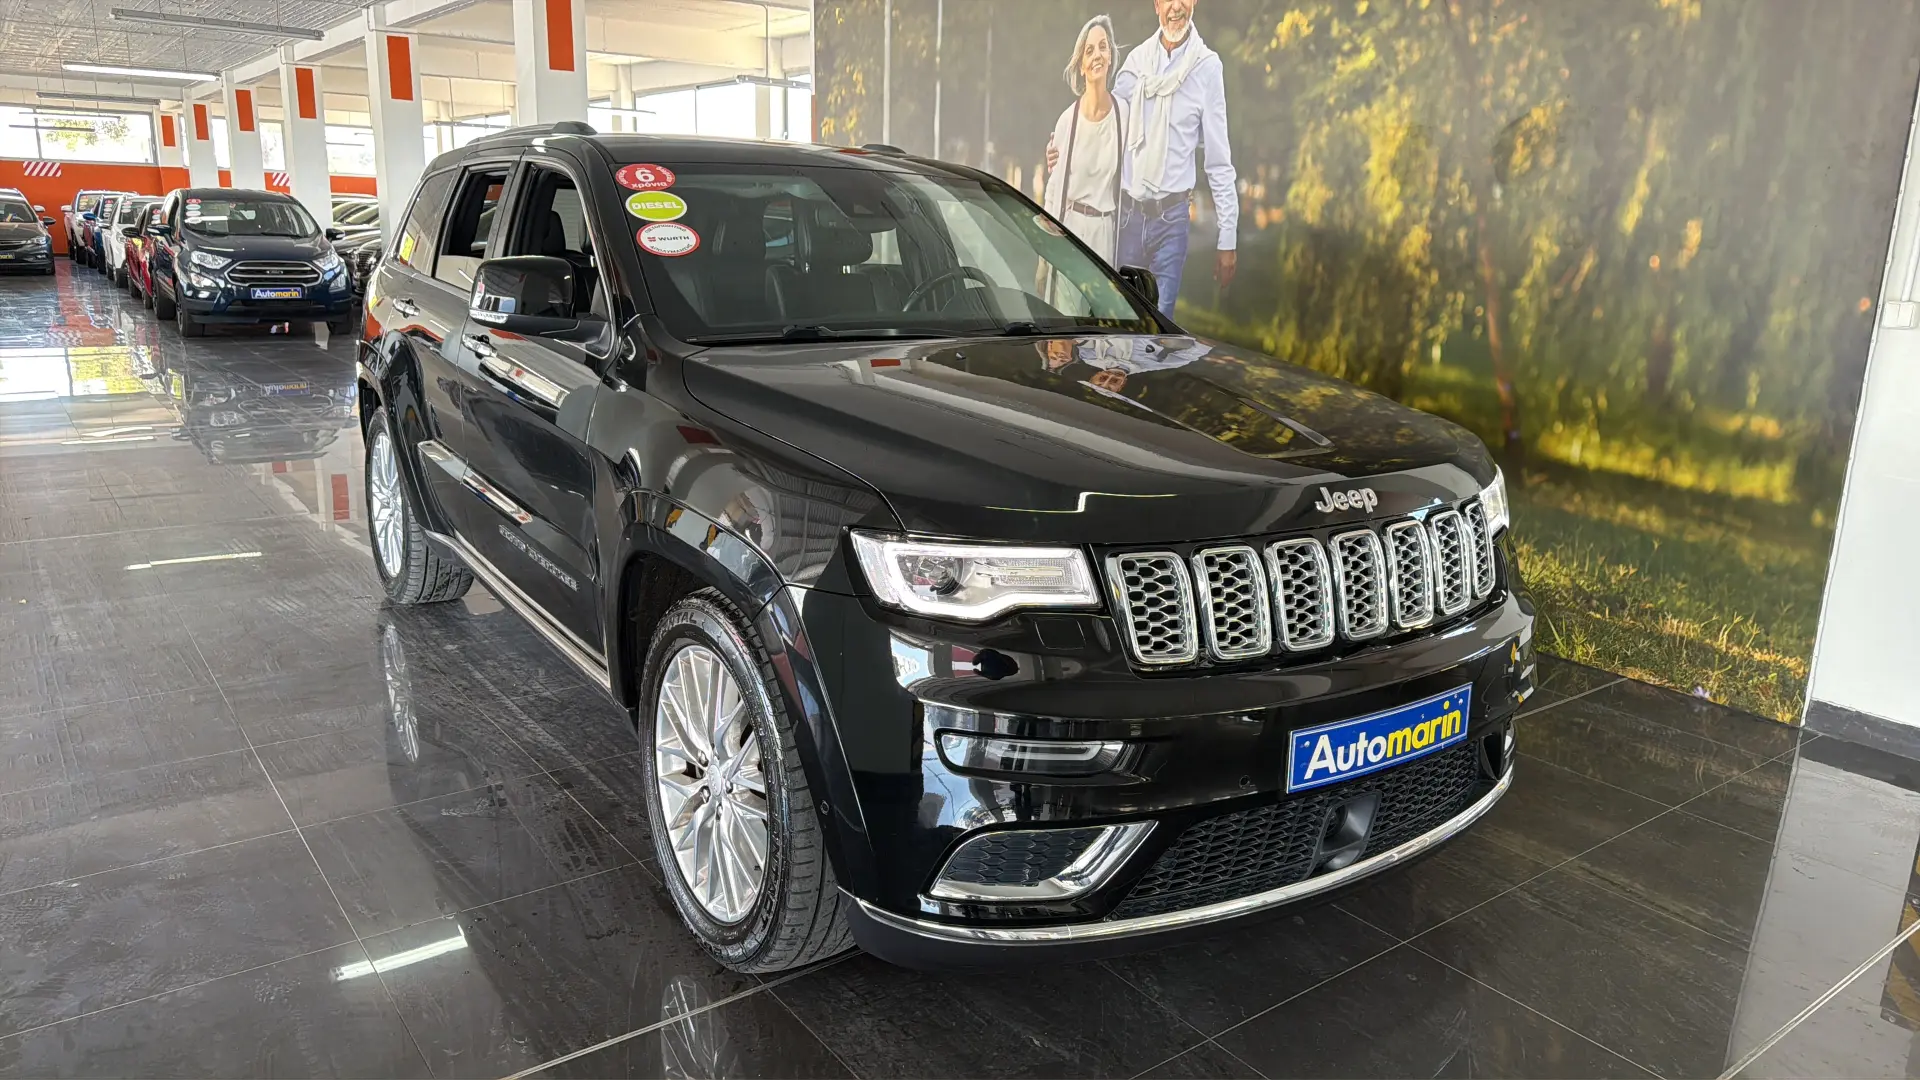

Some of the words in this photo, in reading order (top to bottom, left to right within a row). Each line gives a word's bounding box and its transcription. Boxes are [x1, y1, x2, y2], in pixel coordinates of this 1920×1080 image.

[636, 169, 655, 182] 6
[631, 181, 668, 189] χρόνια
[632, 202, 681, 210] DIESEL
[254, 288, 299, 298] Automarin
[1314, 486, 1378, 513] Jeep
[1304, 700, 1461, 780] Automarin
